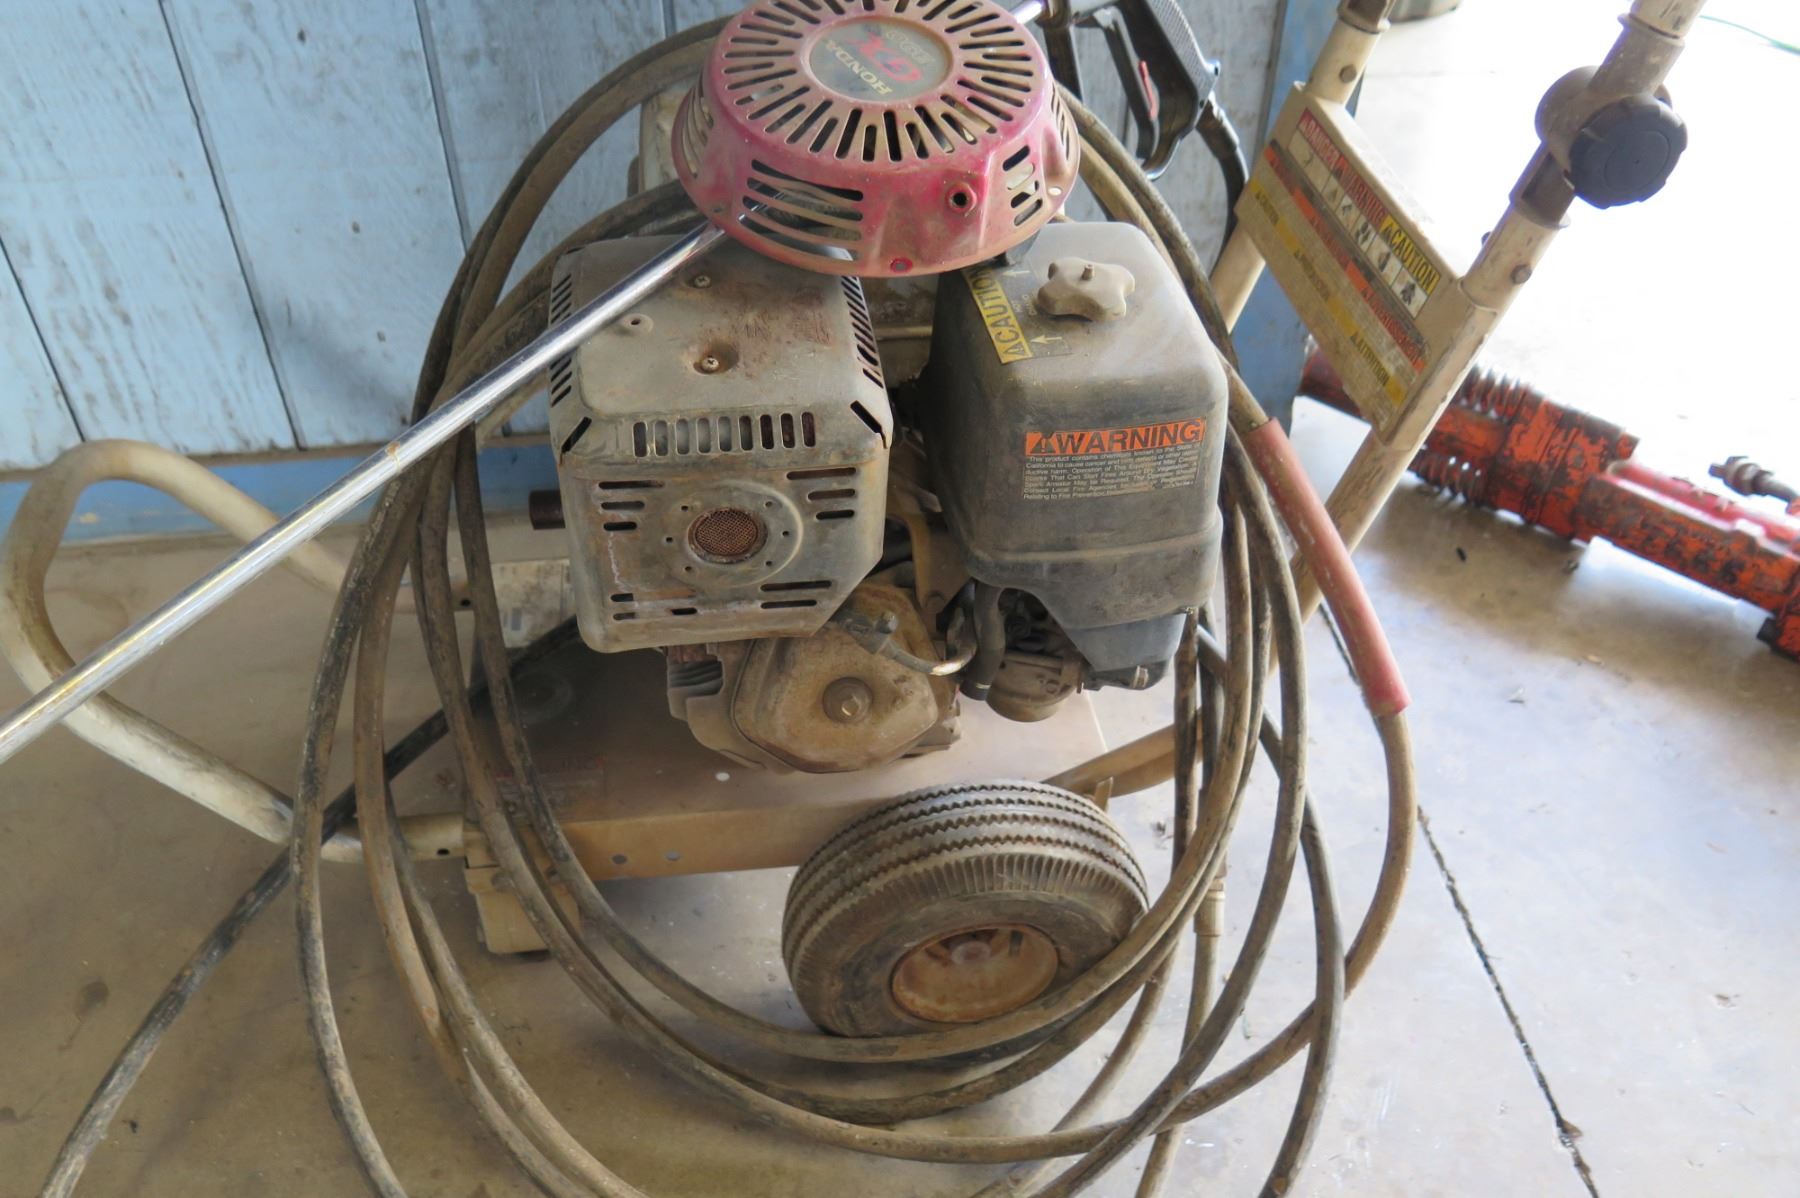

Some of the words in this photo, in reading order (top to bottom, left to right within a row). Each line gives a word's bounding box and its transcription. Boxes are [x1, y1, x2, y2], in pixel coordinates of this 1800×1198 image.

[826, 40, 893, 95] HONDA
[1391, 227, 1438, 292] CAUTION
[1055, 418, 1201, 455] WARNING
